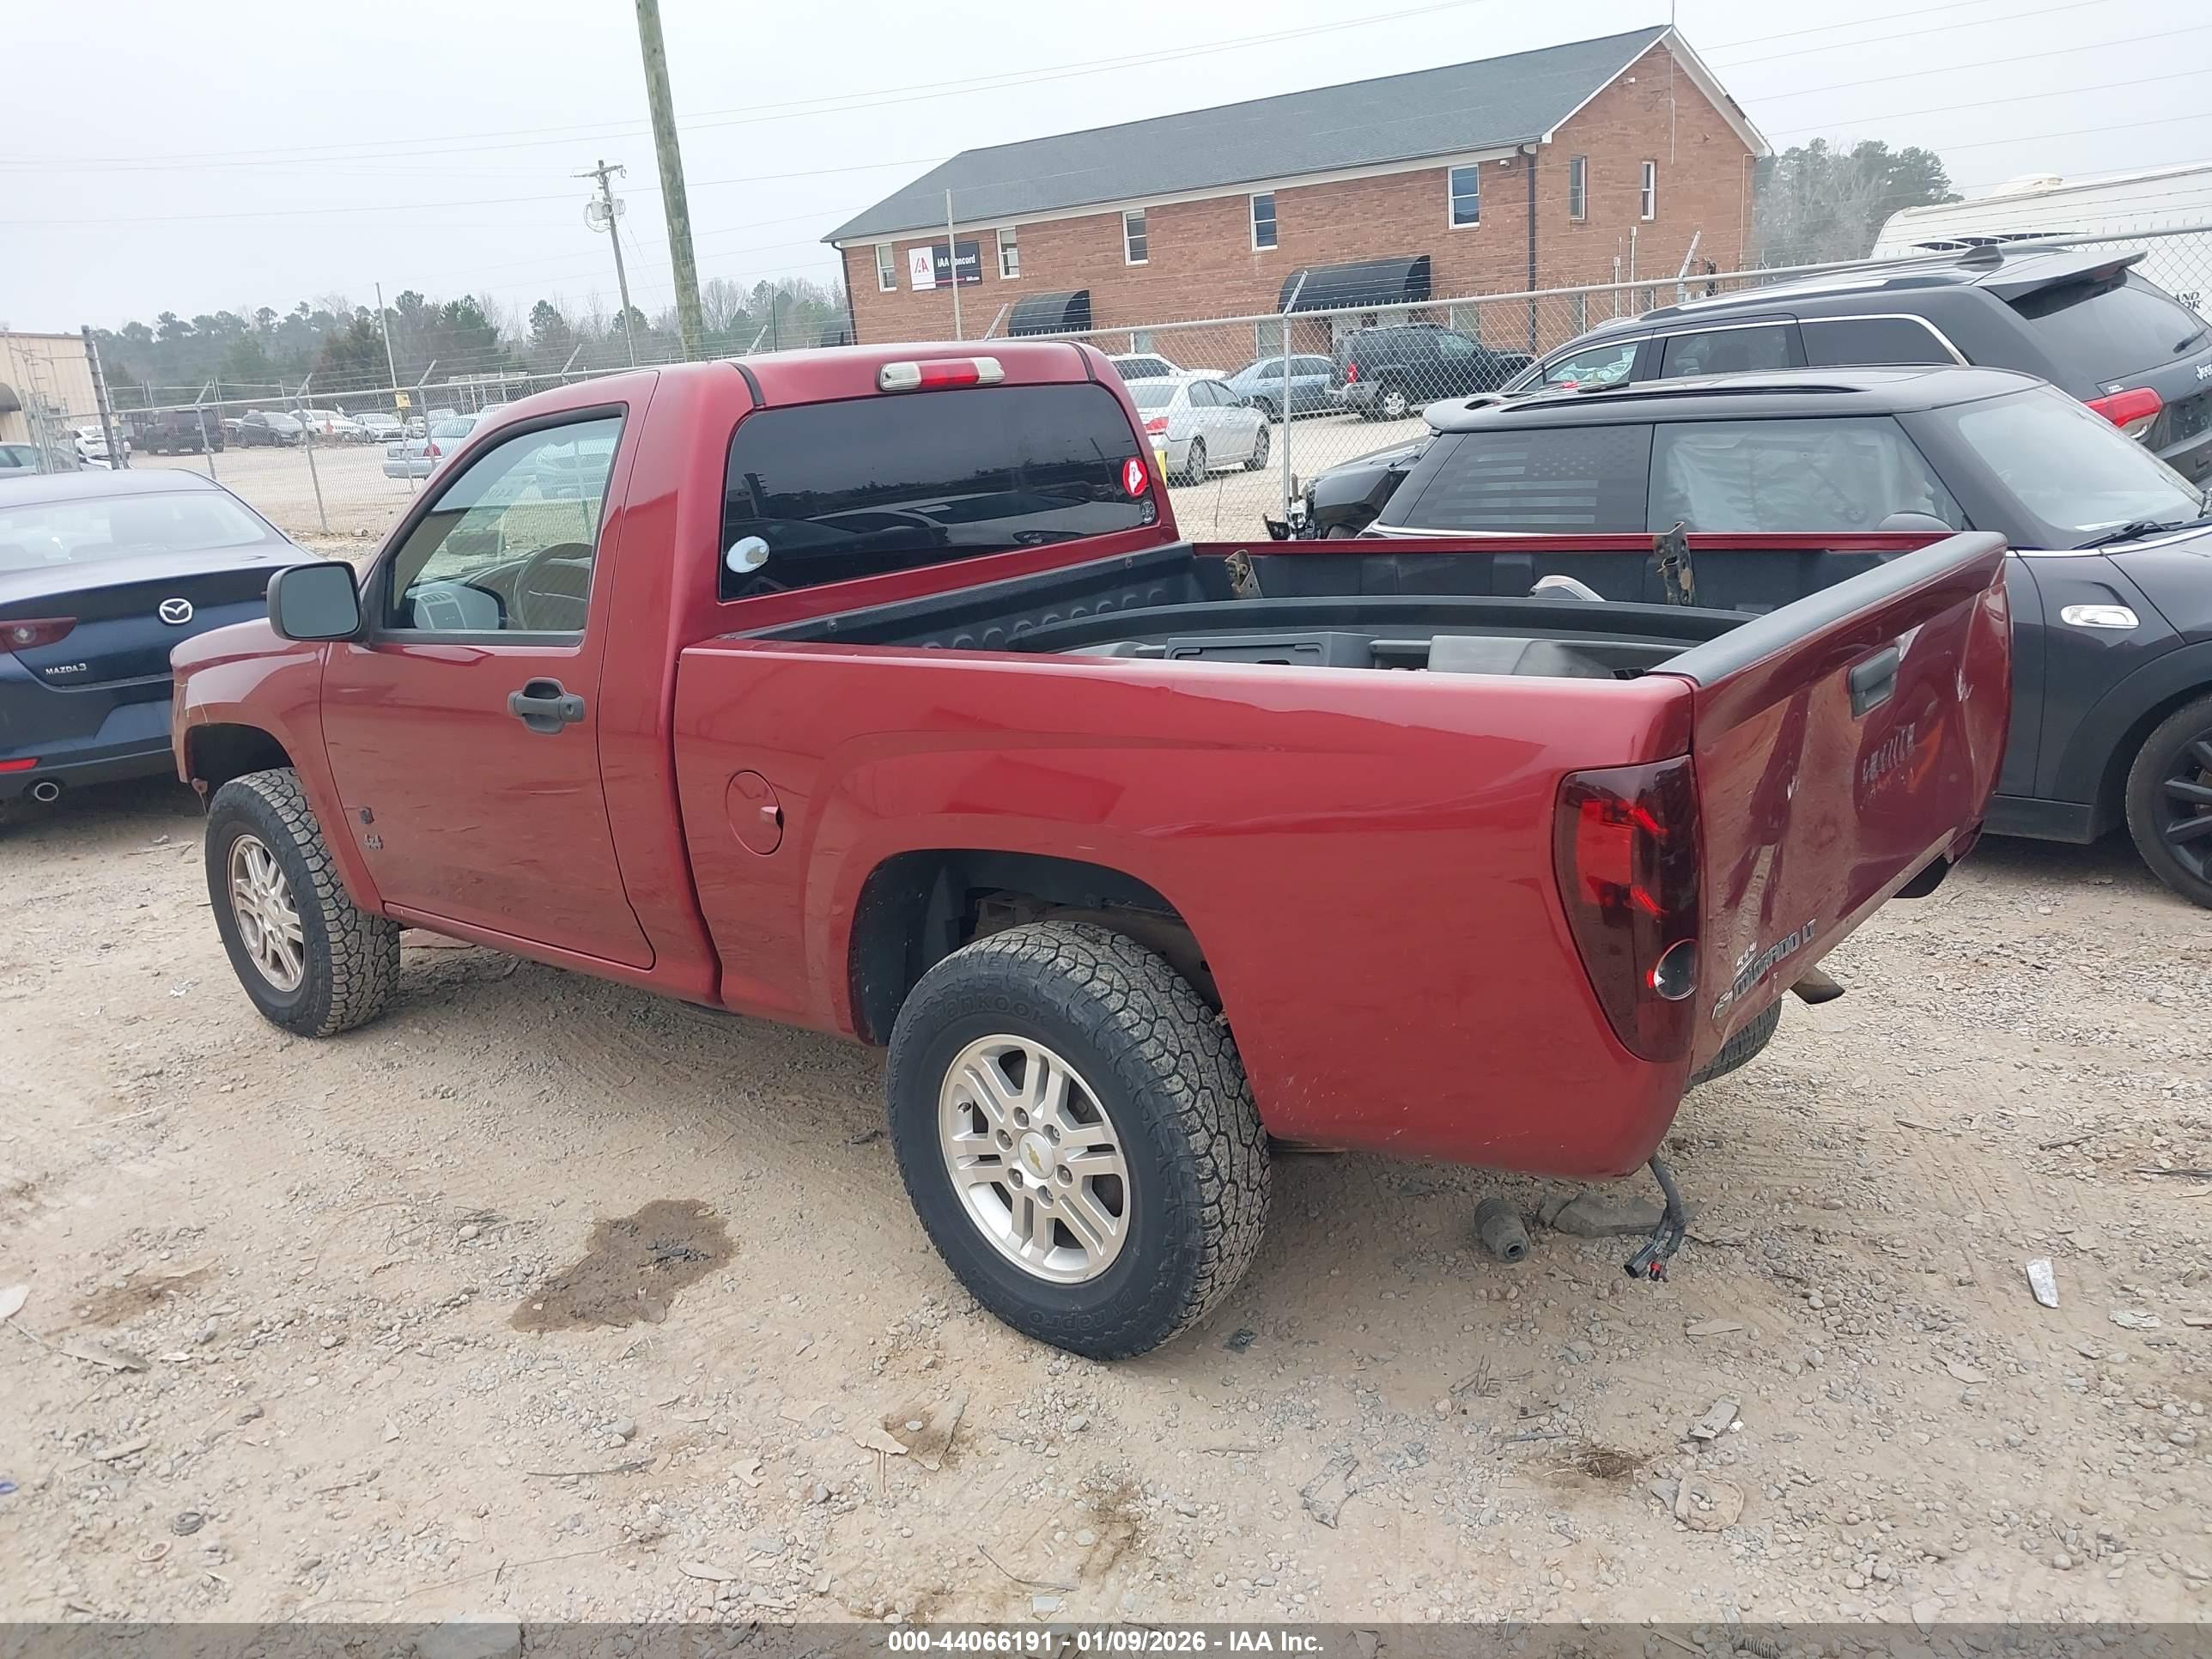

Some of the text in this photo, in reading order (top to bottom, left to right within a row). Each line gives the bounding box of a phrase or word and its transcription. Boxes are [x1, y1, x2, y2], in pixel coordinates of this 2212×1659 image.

[937, 257, 950, 268] IAA
[1732, 931, 1800, 1003] COLORADO
[1802, 918, 1817, 945] LT
